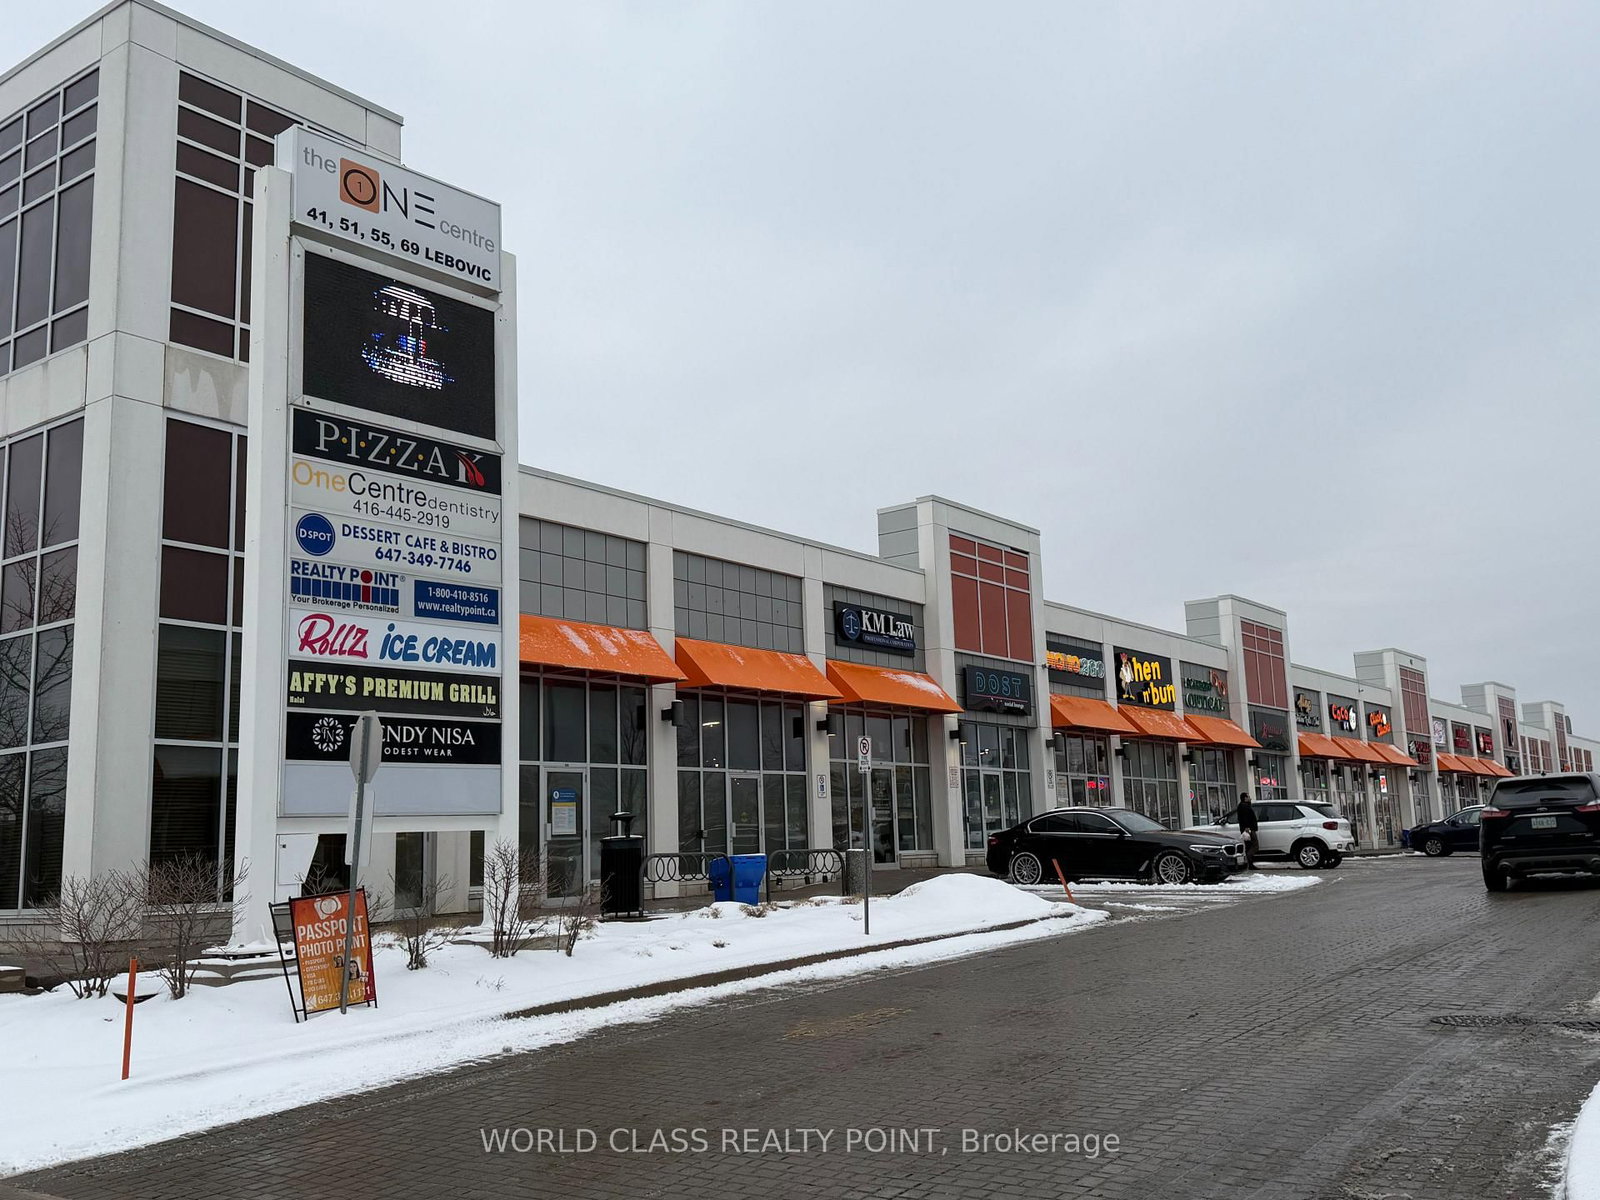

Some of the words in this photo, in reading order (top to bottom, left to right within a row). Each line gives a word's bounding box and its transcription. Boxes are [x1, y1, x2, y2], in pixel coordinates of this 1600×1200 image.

[303, 146, 337, 174] the
[440, 219, 495, 253] centre
[306, 207, 333, 229] 41,
[339, 217, 365, 240] 51,
[371, 228, 395, 250] 55,
[400, 239, 420, 256] 69
[425, 247, 492, 282] LEBOVIC
[353, 499, 450, 529] 416-445-2919
[342, 523, 401, 545] DESSERT
[405, 534, 437, 551] CAFE
[440, 541, 450, 554] &
[452, 542, 497, 561] BISTRO
[291, 560, 346, 580] REALTY
[375, 546, 472, 573] 647-349-7746
[291, 594, 310, 604] Your
[312, 597, 351, 609] Brokerage
[353, 601, 400, 614] Personalized
[428, 586, 489, 603] 1-800-410-8516
[417, 600, 496, 618] www.realtypoint.ca
[861, 610, 886, 635] KM
[887, 615, 915, 640] Law
[422, 636, 497, 668] CREAM
[1132, 656, 1161, 682] hen
[290, 671, 357, 696] AFFY'S
[363, 676, 444, 702] PREMIUM
[449, 683, 497, 705] GRILL
[976, 671, 1022, 698] DOST
[432, 727, 476, 746] NISA
[384, 746, 419, 756] ODEST
[424, 748, 453, 757] WEAR
[300, 940, 334, 959] PHOTO
